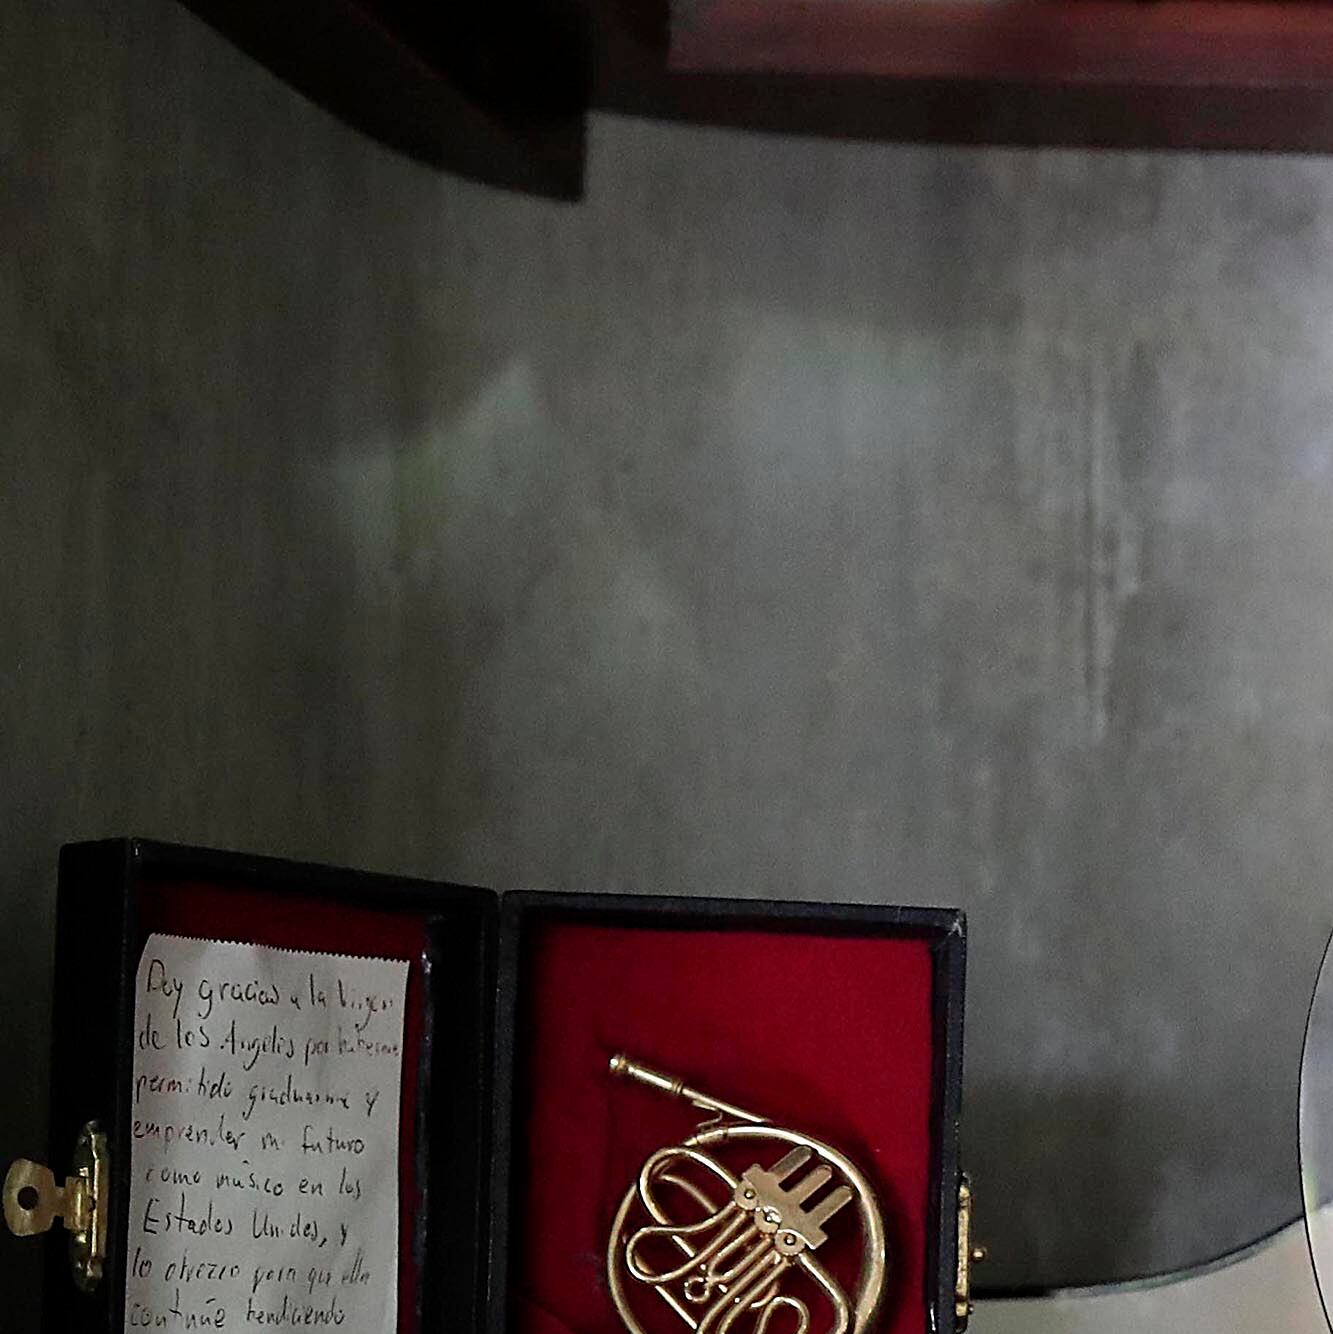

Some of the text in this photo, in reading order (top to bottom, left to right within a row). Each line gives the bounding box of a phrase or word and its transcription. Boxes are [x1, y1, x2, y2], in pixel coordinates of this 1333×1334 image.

[197, 978, 280, 1018] gracias
[310, 972, 326, 1008] la
[139, 1013, 165, 1050] de
[176, 1017, 210, 1050] los
[136, 1066, 233, 1104] permitido
[365, 1091, 379, 1116] y
[133, 1114, 246, 1153] emprender
[302, 1125, 365, 1155] futuro
[145, 1168, 201, 1186] como
[299, 1177, 323, 1196] en
[339, 1167, 361, 1201] los
[143, 1191, 233, 1236] Estados
[340, 1224, 348, 1247] y
[132, 1247, 152, 1279] lo
[252, 1265, 296, 1293] para
